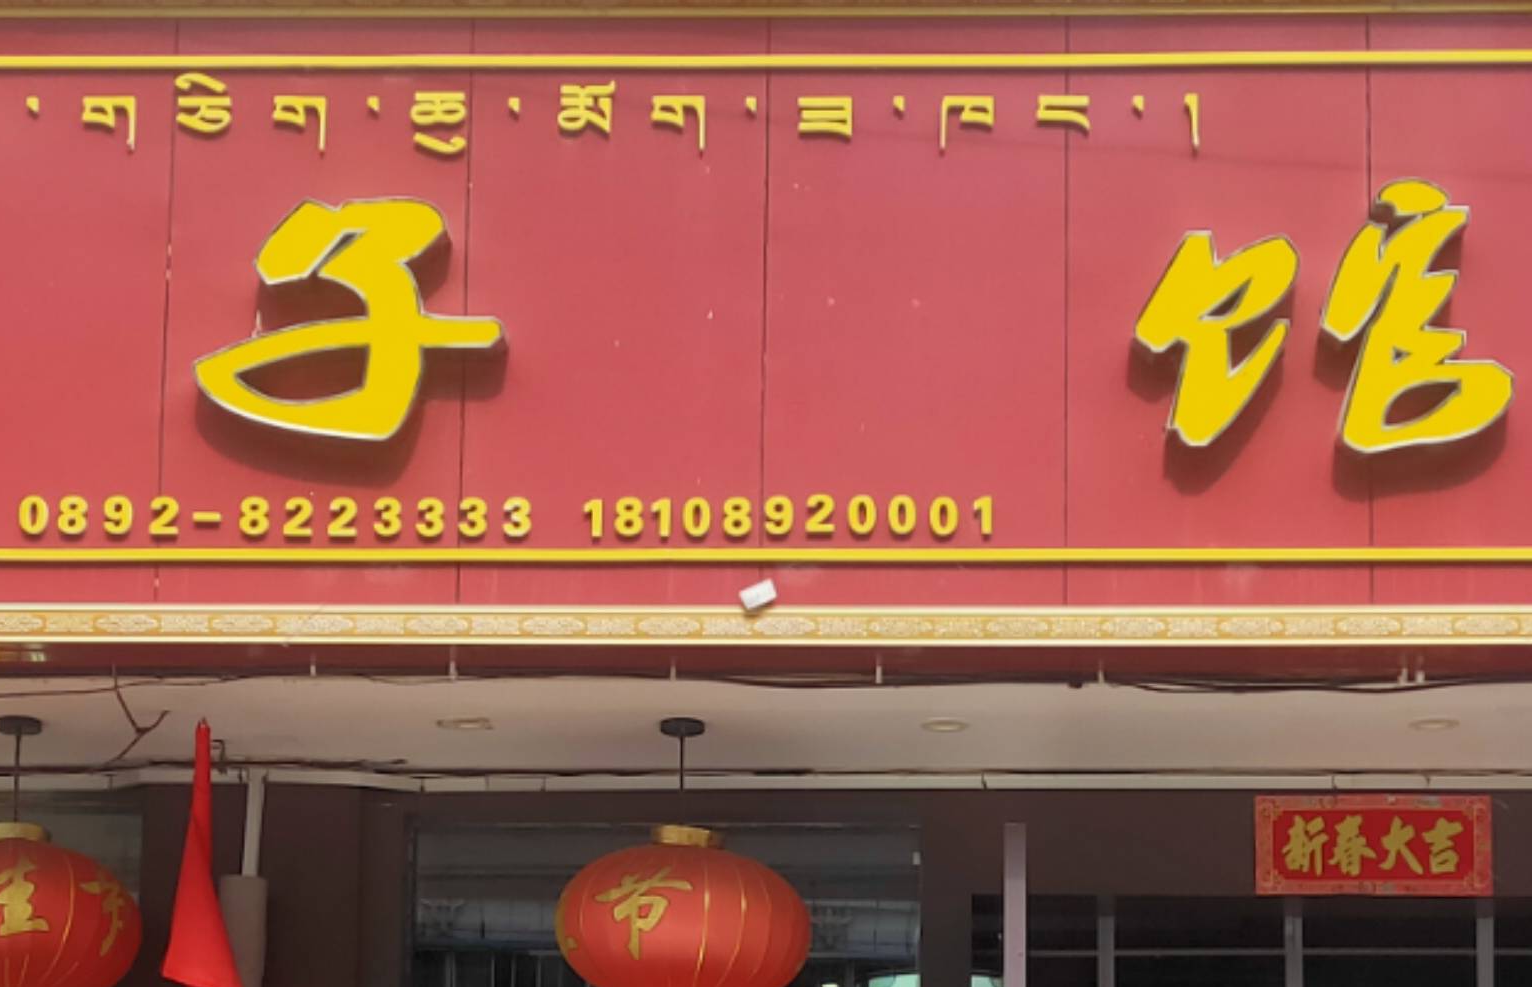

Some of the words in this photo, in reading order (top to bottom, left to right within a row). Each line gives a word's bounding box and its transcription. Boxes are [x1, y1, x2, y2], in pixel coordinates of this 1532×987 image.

[20, 497, 529, 536] 0892-8223333
[587, 496, 991, 535] 18108920001
[1280, 815, 1465, 878] 新春大吉
